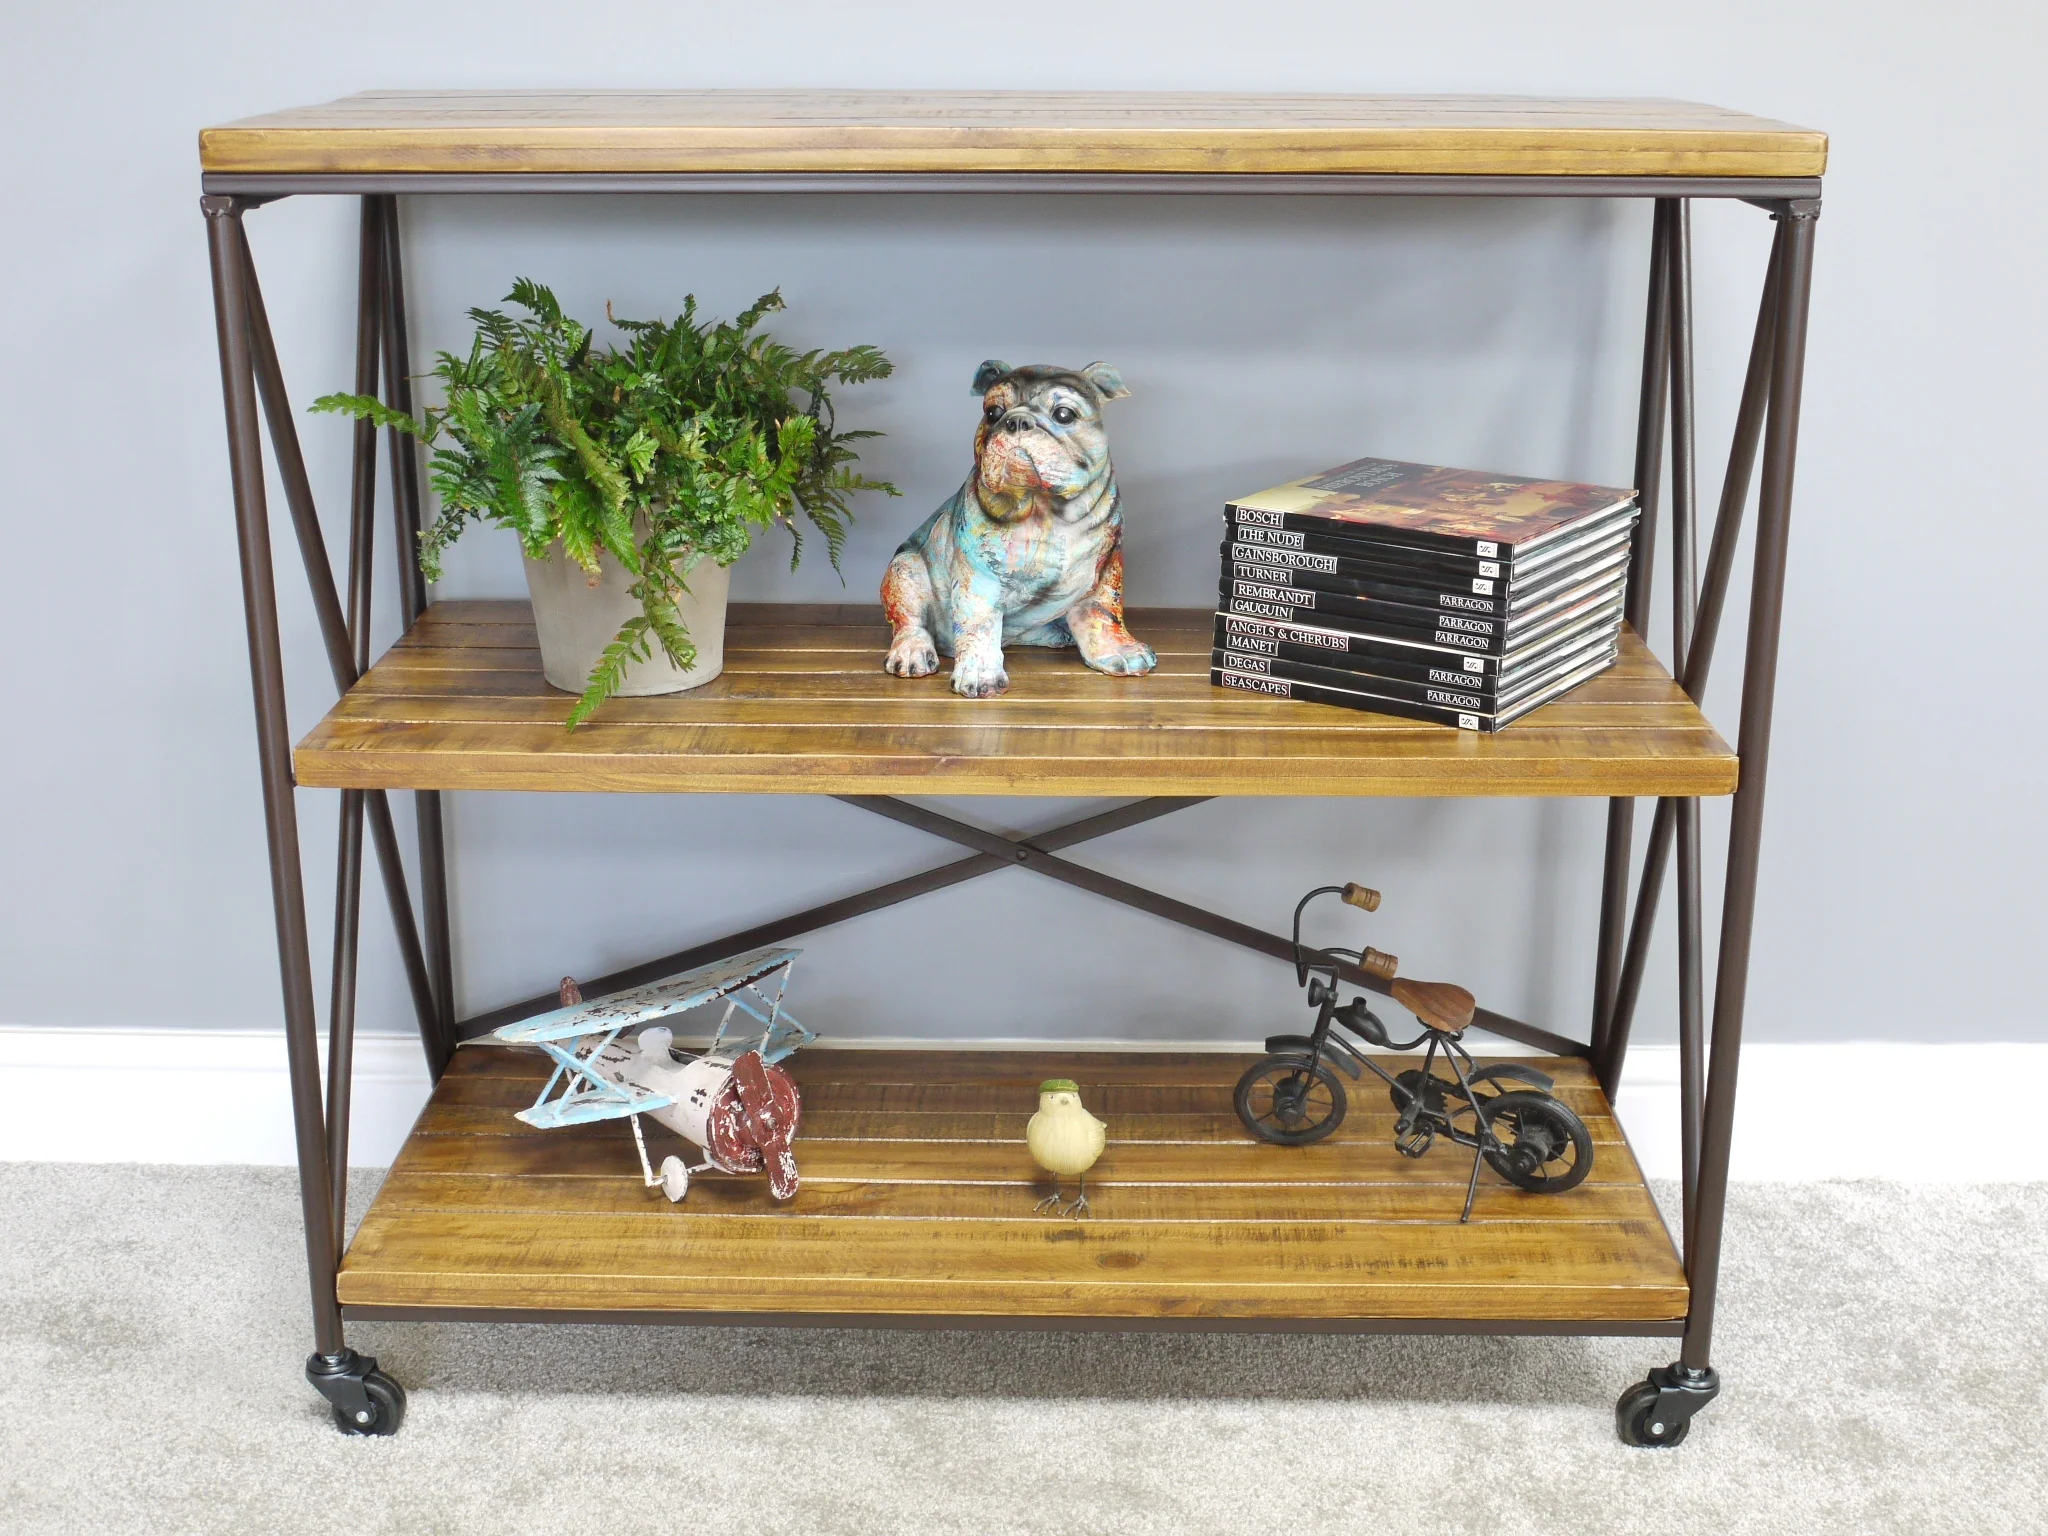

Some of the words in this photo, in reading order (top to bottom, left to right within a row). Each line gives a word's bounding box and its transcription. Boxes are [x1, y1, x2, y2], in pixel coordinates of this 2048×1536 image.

[1239, 509, 1280, 525] BOSCH
[1241, 528, 1265, 541] THE
[1267, 532, 1301, 547] NUDE
[1235, 547, 1334, 571] GAINSBOROUGH
[1238, 565, 1288, 583] TURNER
[1238, 583, 1311, 605] REMBRANDT
[1235, 600, 1289, 618] GAUGUIN
[1440, 595, 1493, 612] PARRAGON
[1439, 616, 1493, 633] PARRAGON
[1230, 620, 1275, 637] ANGELS
[1277, 629, 1288, 640] &
[1290, 630, 1346, 649] CHERUBS
[1435, 631, 1489, 649] PARRAGON
[1231, 635, 1275, 653] MANET
[1228, 655, 1266, 672] DEGAS
[1225, 675, 1288, 696] SEASCAPES
[1429, 670, 1482, 688] PARRAGON
[1427, 690, 1480, 708] PARRAGON
